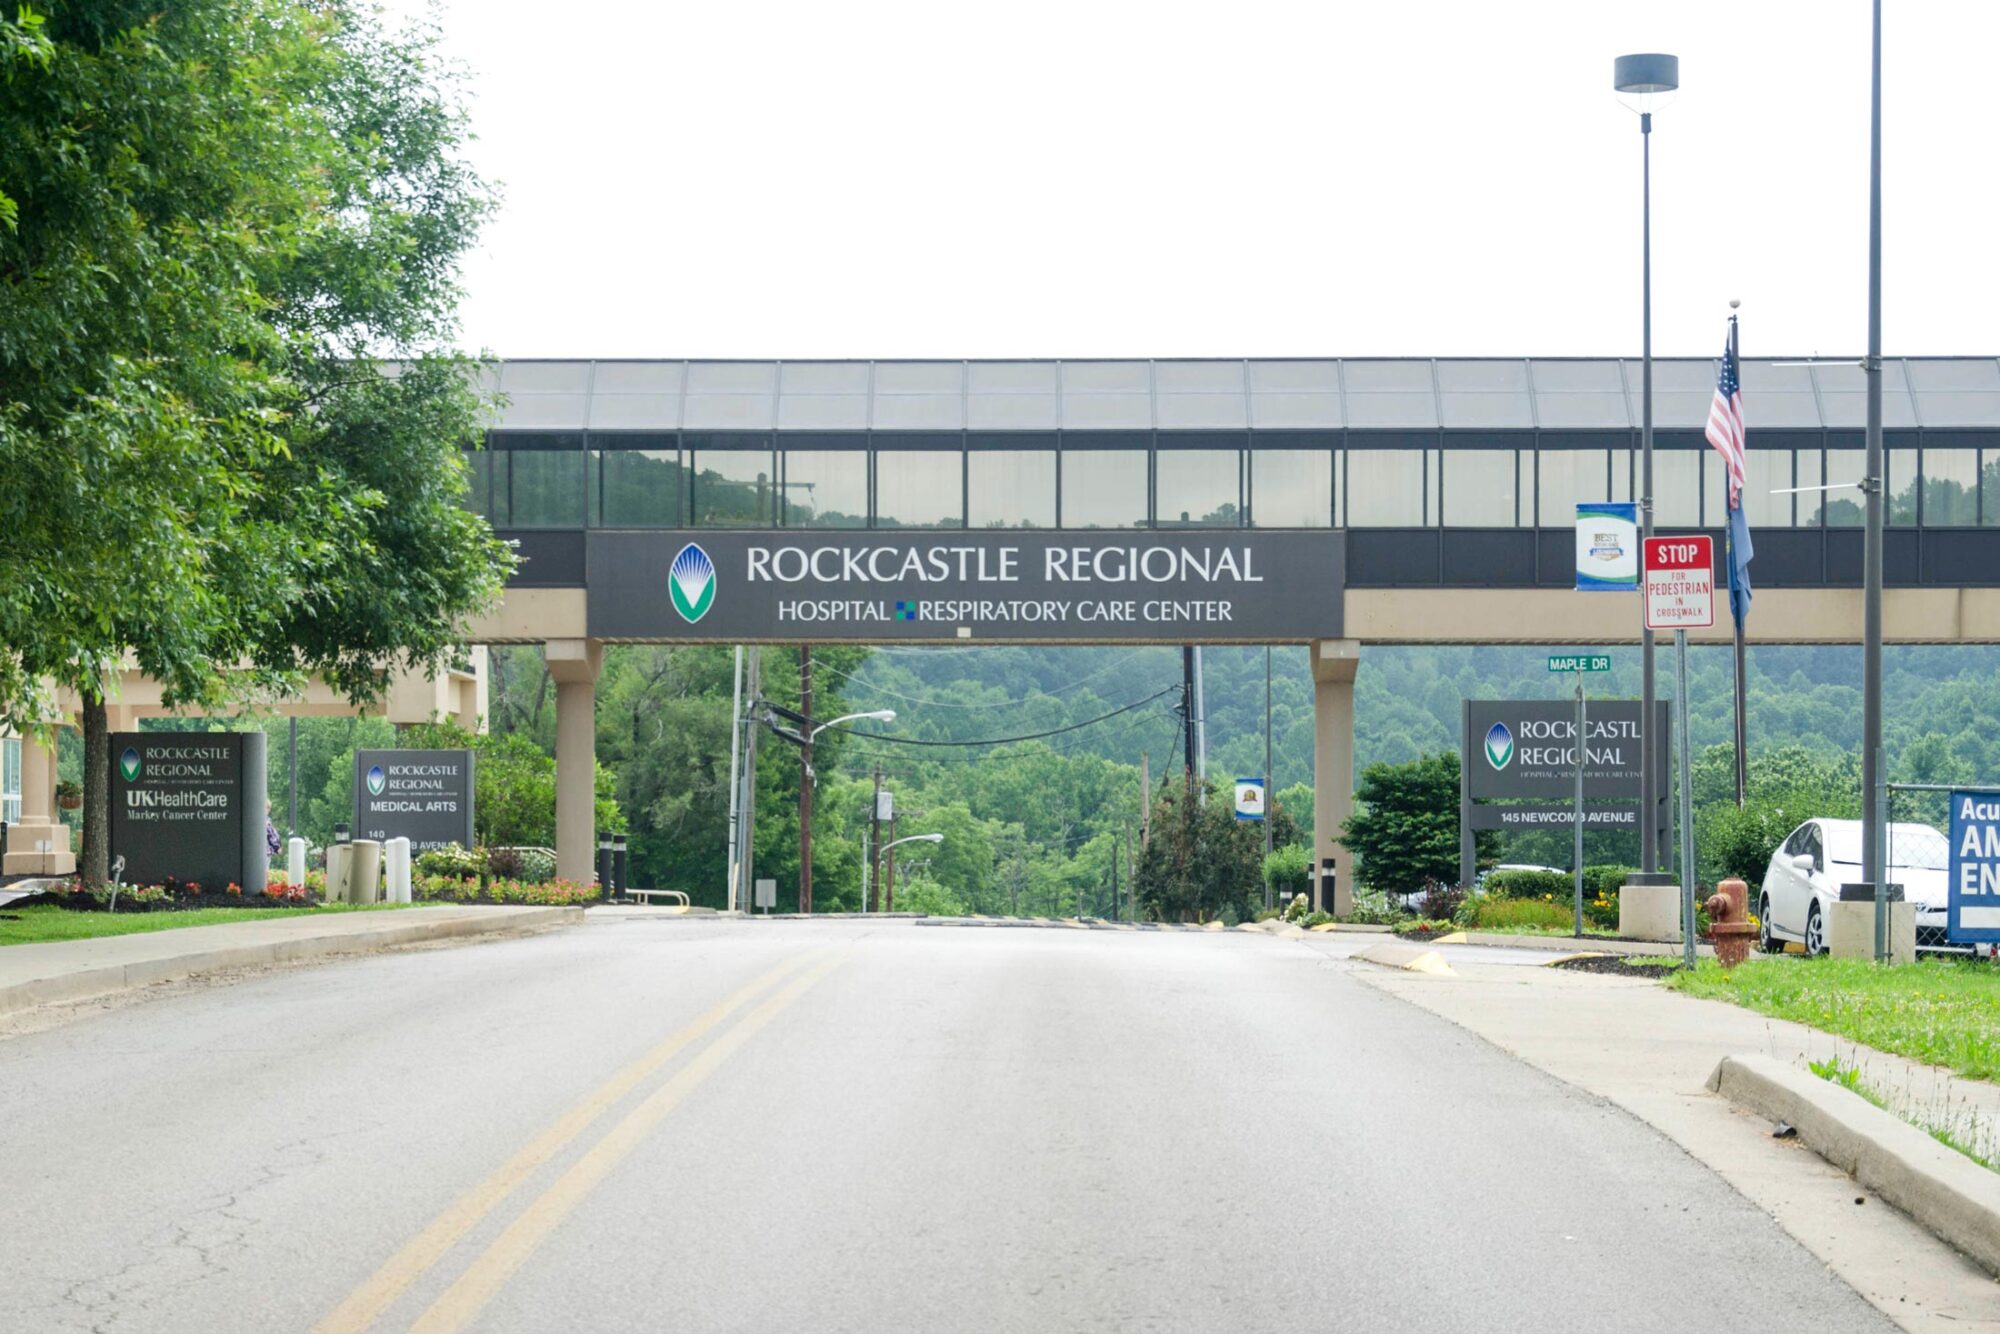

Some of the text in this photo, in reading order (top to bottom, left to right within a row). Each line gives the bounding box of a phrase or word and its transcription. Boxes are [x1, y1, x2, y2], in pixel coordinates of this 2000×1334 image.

[1593, 533, 1618, 542] BEST
[1658, 544, 1698, 564] STOP
[747, 546, 1263, 582] ROCKCASTLE REGIONAL
[1671, 572, 1686, 580] FOR
[1650, 582, 1709, 596] PEDESTRIAN
[1675, 597, 1684, 606] IN
[779, 601, 1232, 621] HOSPITAL RESPIRATORY CARE CENTER
[1656, 607, 1703, 617] CROSSWALK
[1550, 657, 1608, 670] MAPLE DR
[1520, 721, 1641, 738] ROCKCASTL
[146, 748, 230, 759] ROCKCASTLE
[146, 764, 212, 776] REGIONAL
[389, 765, 458, 775] ROCKCASTLE
[389, 779, 443, 789] REGIONAL
[126, 790, 227, 807] UKHealthCare
[370, 801, 457, 812] MEDICAL ARTS
[128, 810, 228, 822] Markey Cancer Center
[1501, 812, 1520, 822] 145
[1588, 812, 1635, 822] AVENUE
[419, 841, 453, 849] AVENU
